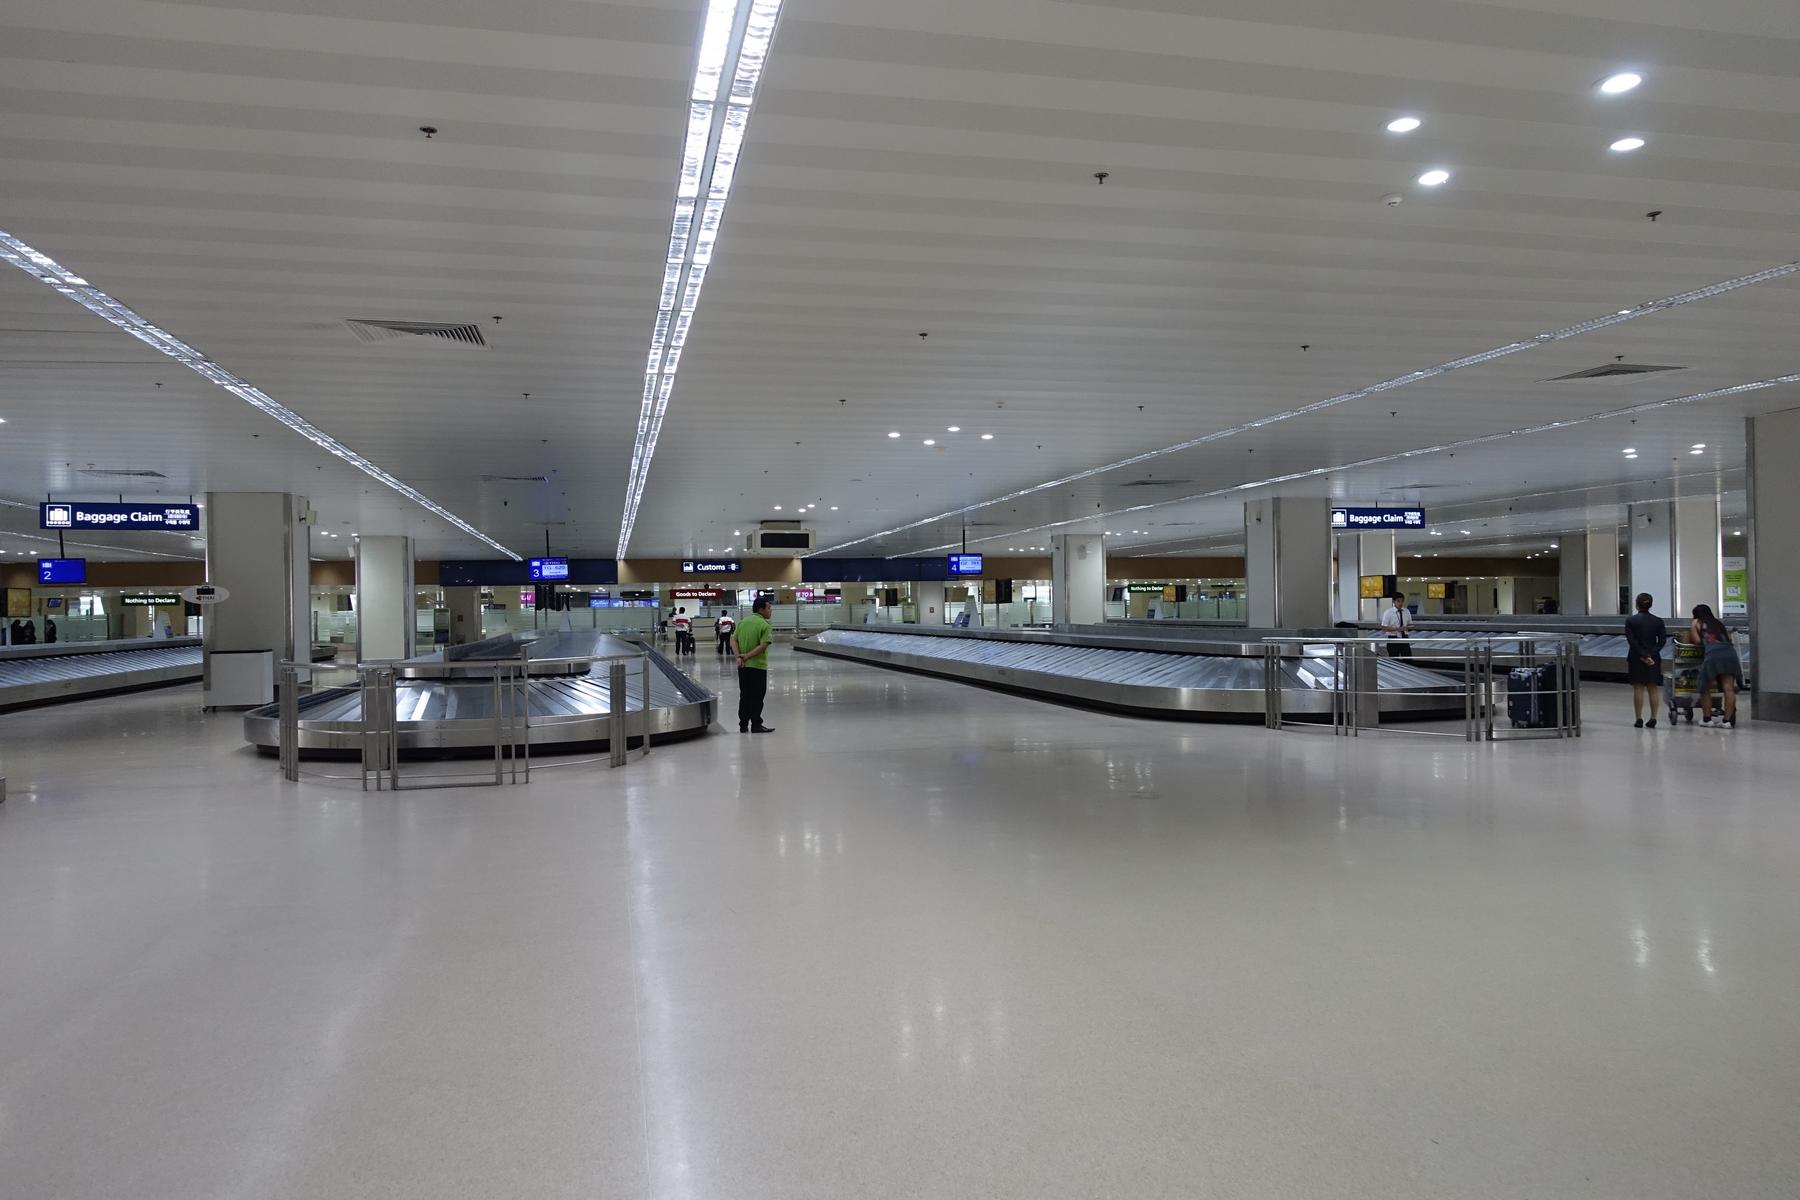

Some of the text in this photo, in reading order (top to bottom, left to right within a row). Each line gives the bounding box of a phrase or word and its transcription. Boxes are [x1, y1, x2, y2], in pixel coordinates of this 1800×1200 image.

[76, 511, 128, 523] Baggage
[130, 511, 163, 522] Claim
[1349, 514, 1382, 524] Baggage
[1383, 514, 1404, 522] Claim
[697, 563, 726, 571] Customs
[43, 571, 52, 580] 2
[533, 569, 540, 577] 3
